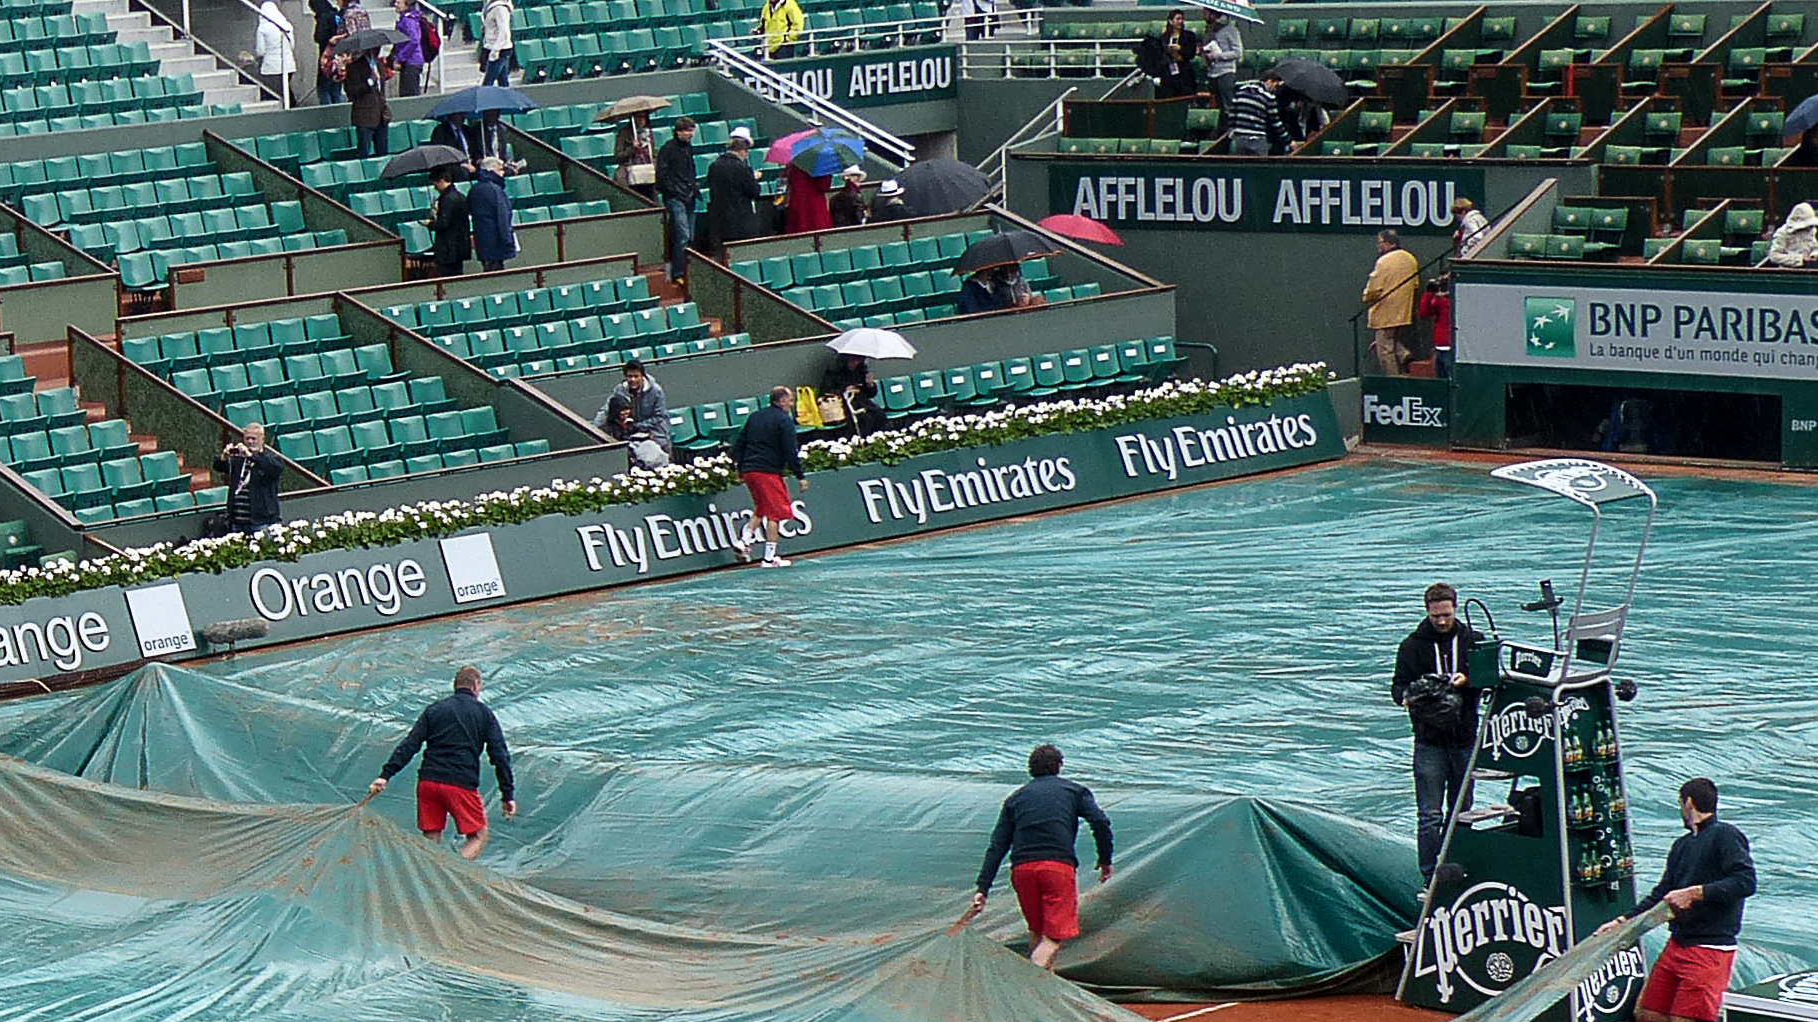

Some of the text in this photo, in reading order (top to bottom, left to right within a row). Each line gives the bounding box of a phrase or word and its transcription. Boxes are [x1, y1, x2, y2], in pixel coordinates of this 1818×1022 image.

[848, 57, 951, 97] AFFLELOU
[1073, 177, 1243, 222] AFFLELOU
[1273, 179, 1456, 227] AFFLELOU
[1588, 302, 1662, 338] BNP
[1589, 343, 1818, 370] La banque d'un monde qui chan
[1363, 394, 1443, 427] FedEx
[1791, 419, 1817, 431] BNP
[249, 558, 427, 622] Orange
